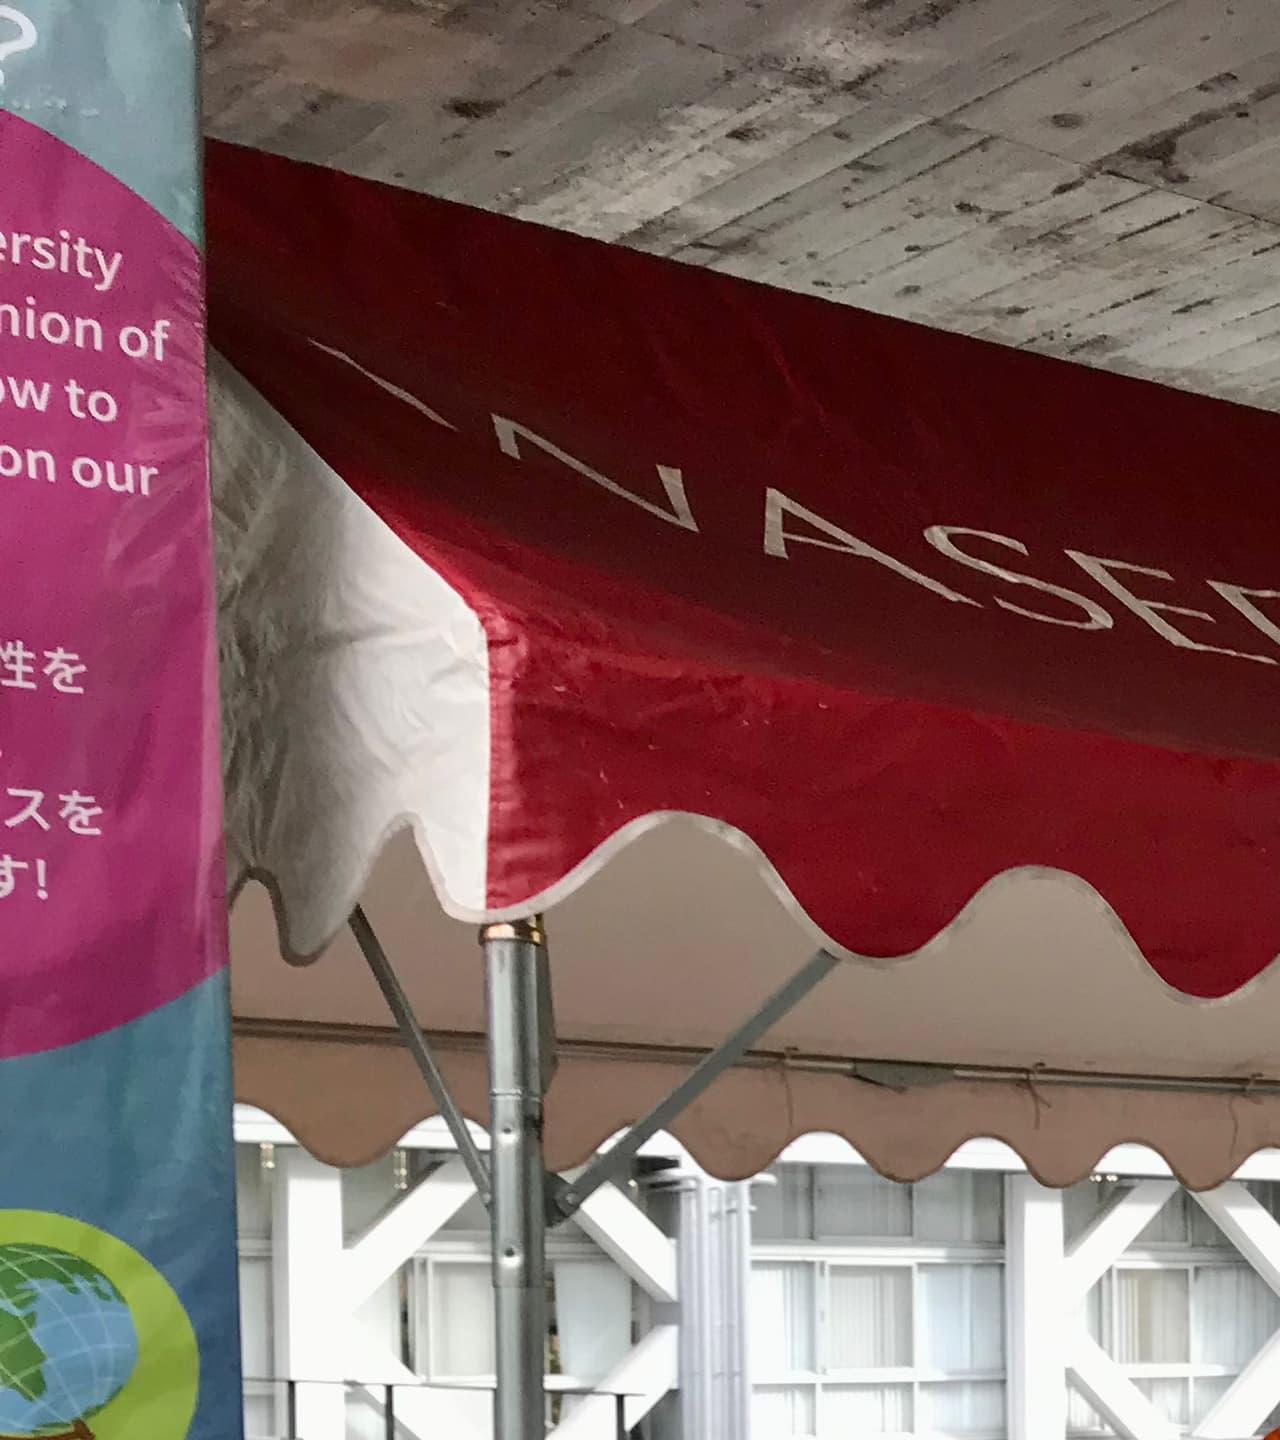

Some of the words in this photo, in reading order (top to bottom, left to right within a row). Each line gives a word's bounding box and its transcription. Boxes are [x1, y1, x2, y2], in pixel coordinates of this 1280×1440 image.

[0, 229, 123, 292] ersity
[118, 319, 171, 362] of
[0, 375, 51, 413] w
[64, 378, 118, 423] to
[71, 456, 160, 496] our
